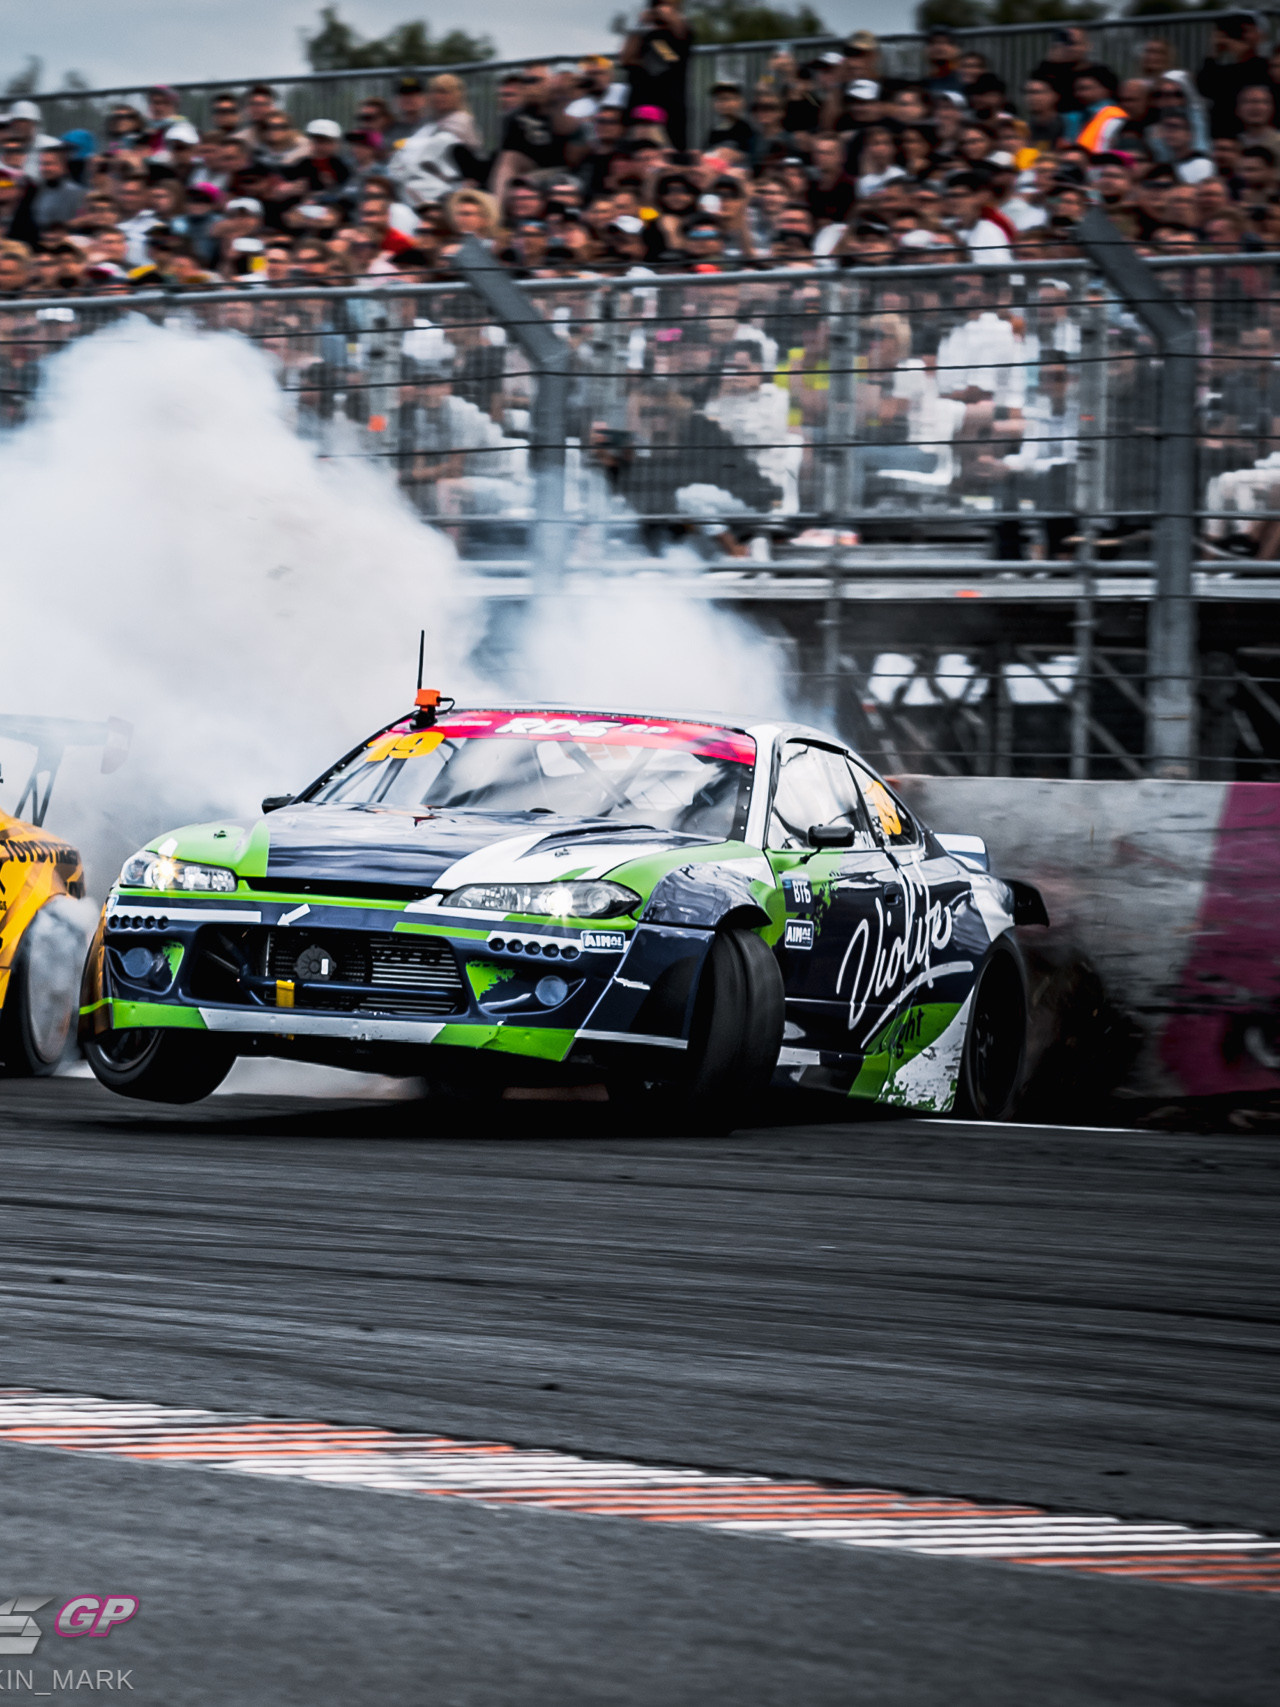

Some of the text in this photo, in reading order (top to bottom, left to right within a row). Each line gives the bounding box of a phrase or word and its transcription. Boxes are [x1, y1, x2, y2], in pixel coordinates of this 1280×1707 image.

[494, 717, 623, 738] RDS
[365, 731, 445, 762] 19
[792, 879, 812, 904] ВТБ
